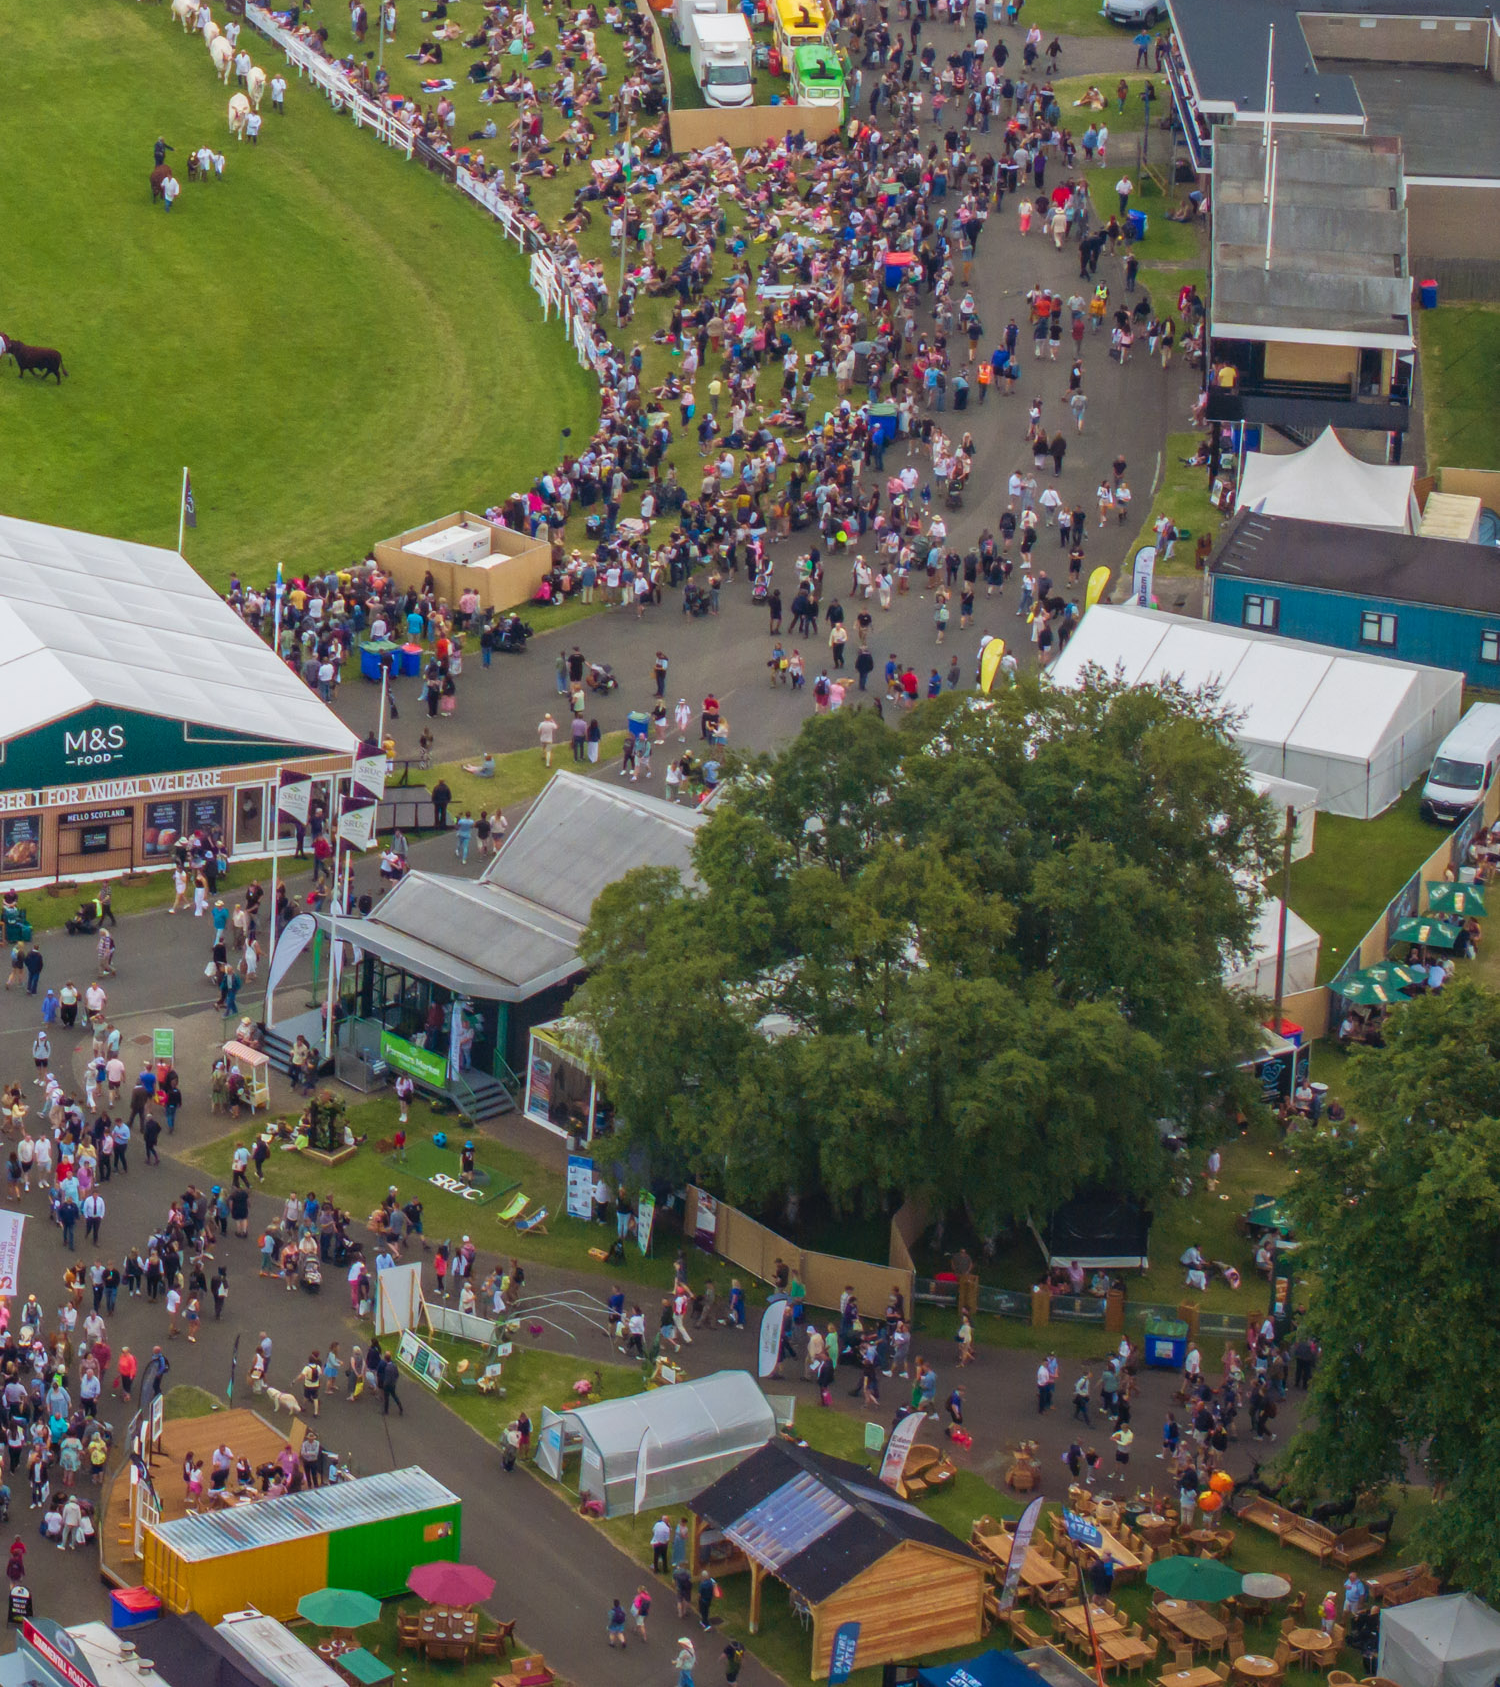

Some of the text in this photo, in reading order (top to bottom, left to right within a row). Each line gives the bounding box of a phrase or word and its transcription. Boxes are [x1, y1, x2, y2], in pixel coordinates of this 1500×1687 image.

[65, 725, 124, 755] M&S
[77, 753, 112, 766] FOOD
[358, 767, 382, 779] SRUC
[31, 791, 40, 808] 1
[46, 787, 79, 806] FOR
[82, 780, 144, 803] ANIMAL
[147, 771, 223, 795] WELFARE
[282, 791, 308, 803] SRUC
[67, 809, 125, 822] HELLO SCOTLAND
[344, 819, 369, 830] SRUC
[429, 1173, 484, 1201] SRUC
[9, 1218, 20, 1251] Estates
[0, 1240, 8, 1276] Scottish
[6, 1258, 14, 1276] Land
[890, 1443, 909, 1451] Home
[892, 1436, 912, 1444] Eden
[32, 1631, 70, 1673] SIMMENTAL
[834, 1633, 848, 1674] SALTIRE
[843, 1640, 856, 1672] GATES
